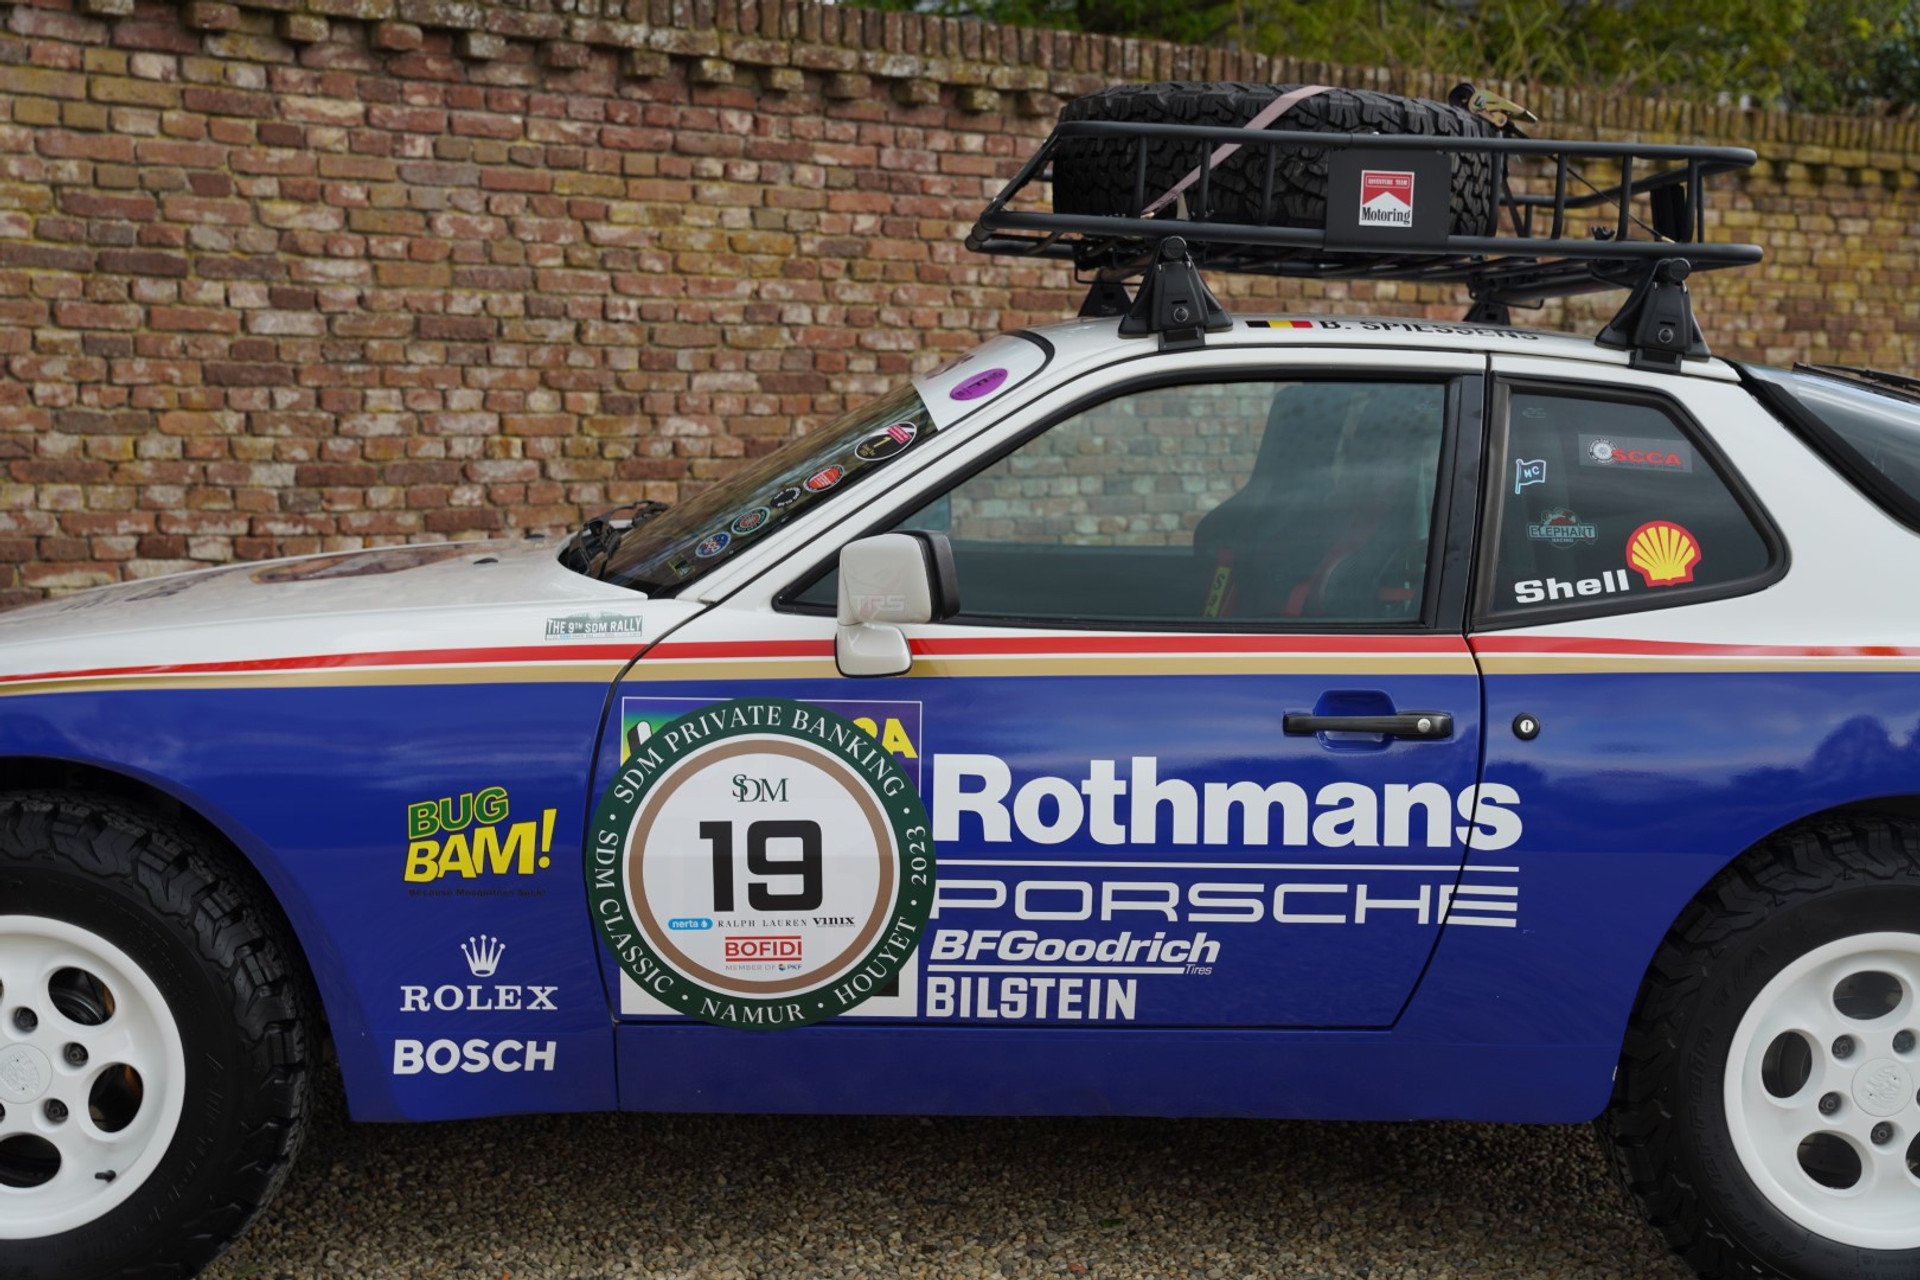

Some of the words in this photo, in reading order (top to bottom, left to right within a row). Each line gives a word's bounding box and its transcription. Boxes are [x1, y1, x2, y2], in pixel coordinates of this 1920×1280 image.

[1361, 206, 1411, 225] Motoring
[1611, 448, 1682, 467] SCCA
[1531, 526, 1594, 537] ELEPHANT
[1514, 569, 1630, 604] Shell
[547, 619, 566, 634] THE
[585, 622, 607, 633] SDM
[610, 616, 643, 632] RALLY
[614, 747, 664, 804] SDM
[663, 704, 782, 753] PRIVATE
[792, 709, 906, 798] BANKING
[732, 773, 789, 803] SDM
[932, 753, 1524, 851] Rothmans
[407, 786, 509, 840] BUG
[403, 808, 558, 883] BAM!
[595, 829, 619, 889] SDM
[906, 825, 928, 886] 2023
[699, 819, 824, 913] 19
[929, 878, 1518, 928] PORSCHE
[672, 919, 699, 929] nerta
[718, 919, 755, 928] RALPH
[762, 919, 808, 927] LAUREN
[599, 895, 674, 995] CLASSIC
[725, 941, 802, 956] BOFIDI
[834, 915, 917, 1007] HOUYET
[928, 928, 1221, 964] BFGoodrich
[787, 963, 803, 971] PKF
[1184, 963, 1213, 976] Tires
[399, 984, 559, 1013] ROLEX
[699, 995, 807, 1025] NAMUR
[926, 976, 1138, 1021] BILSTEIN
[392, 1037, 558, 1075] BOSCH
